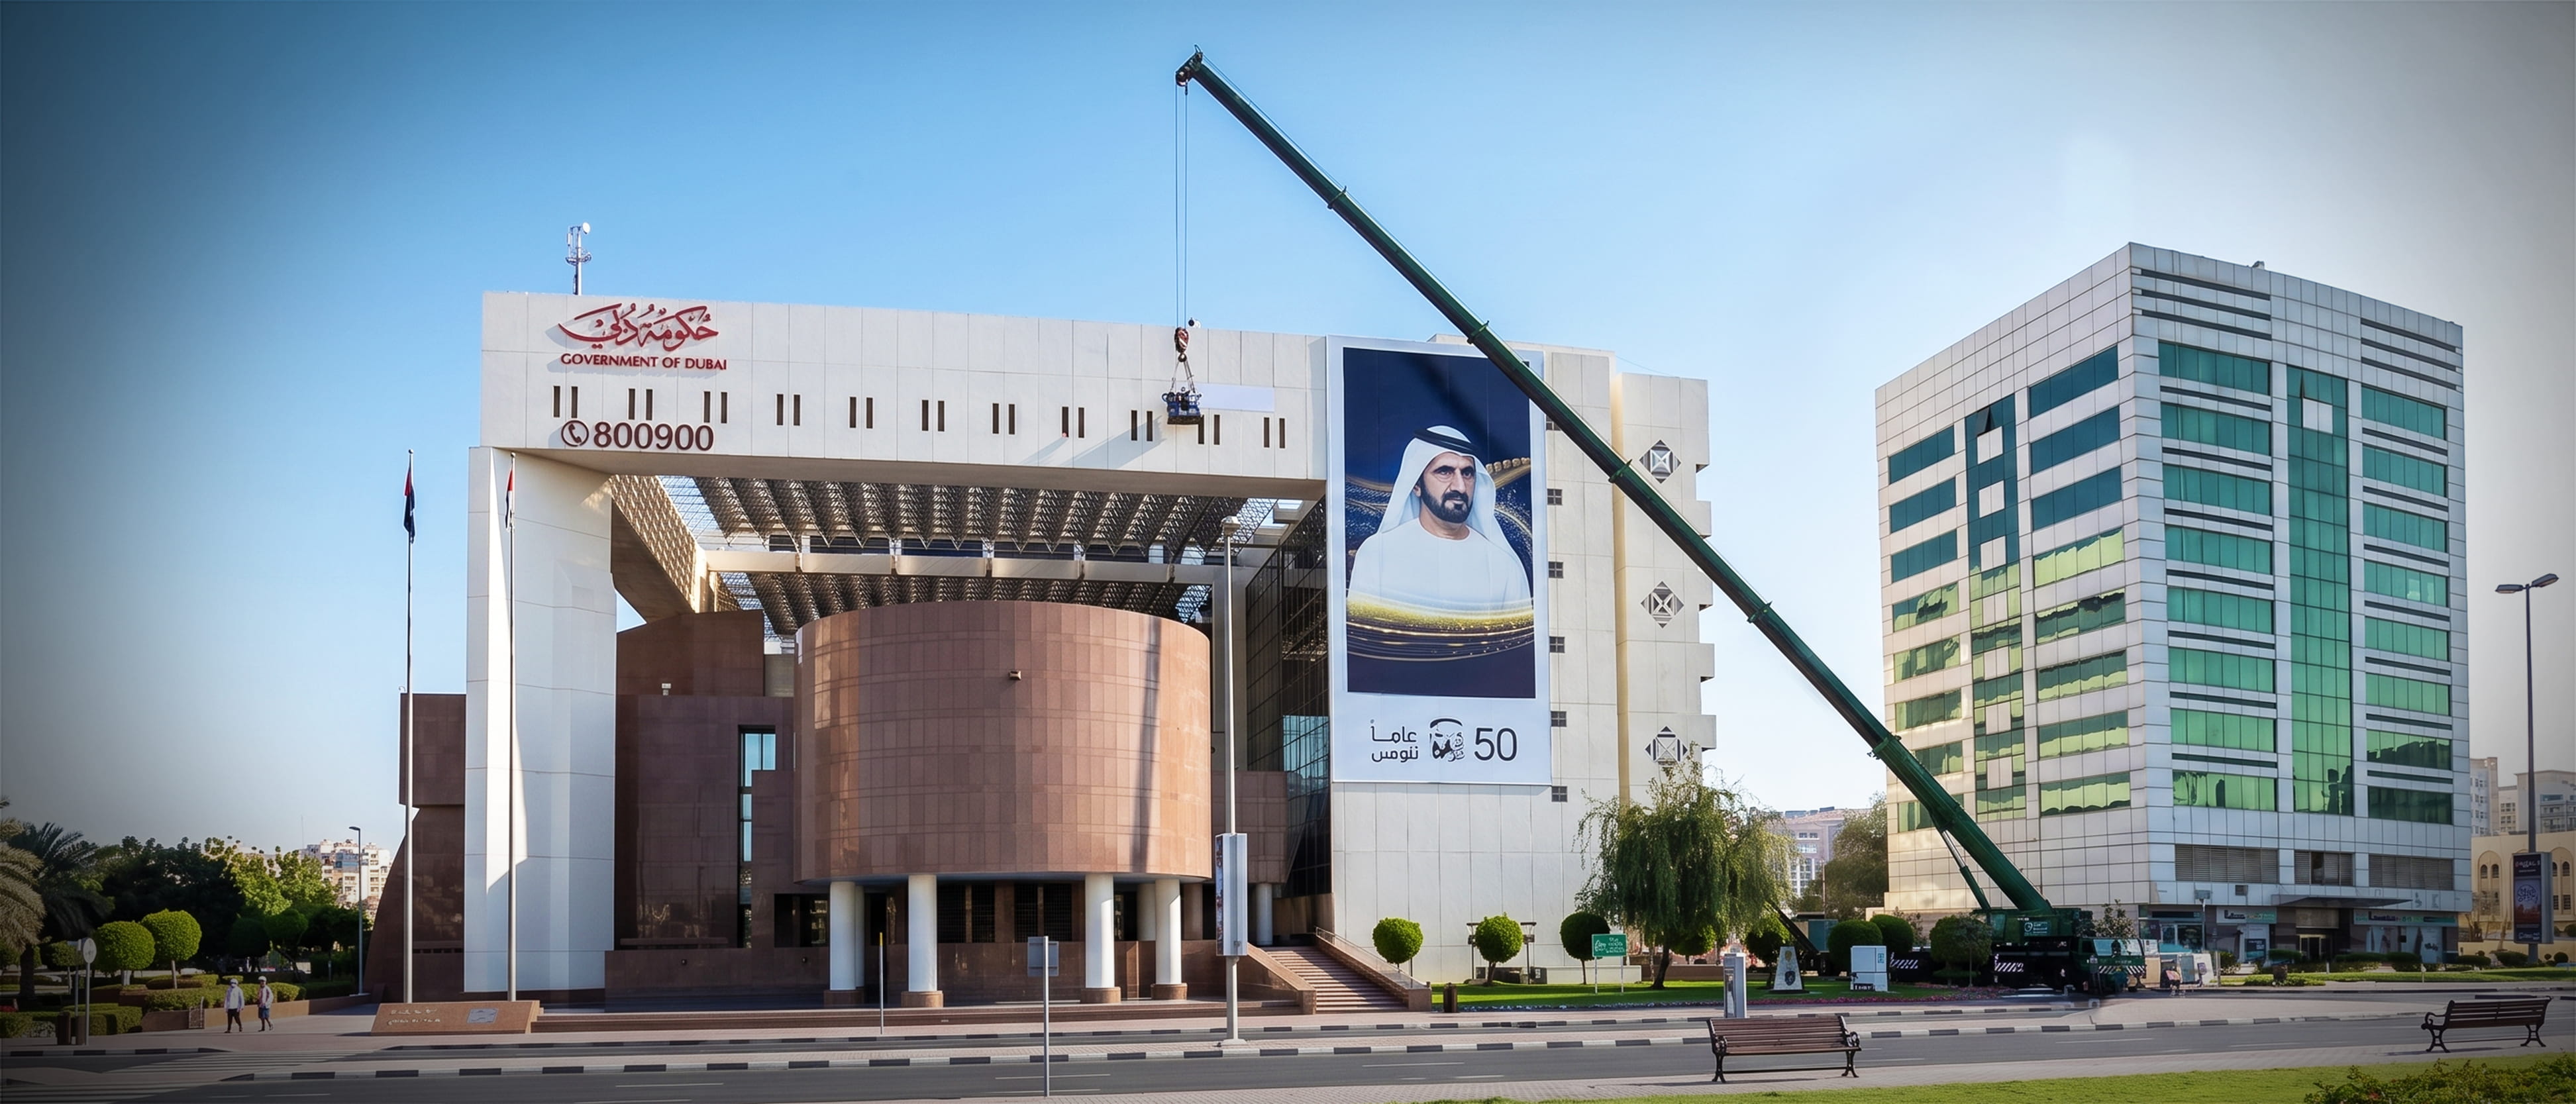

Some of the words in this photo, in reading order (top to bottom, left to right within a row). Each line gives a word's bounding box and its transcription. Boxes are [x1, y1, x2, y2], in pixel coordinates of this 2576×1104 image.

[560, 353, 658, 367] GOVERNMENT
[662, 357, 681, 368] OF
[684, 358, 727, 370] DUBAI
[593, 421, 714, 451] 800900
[1474, 727, 1518, 762] 50
